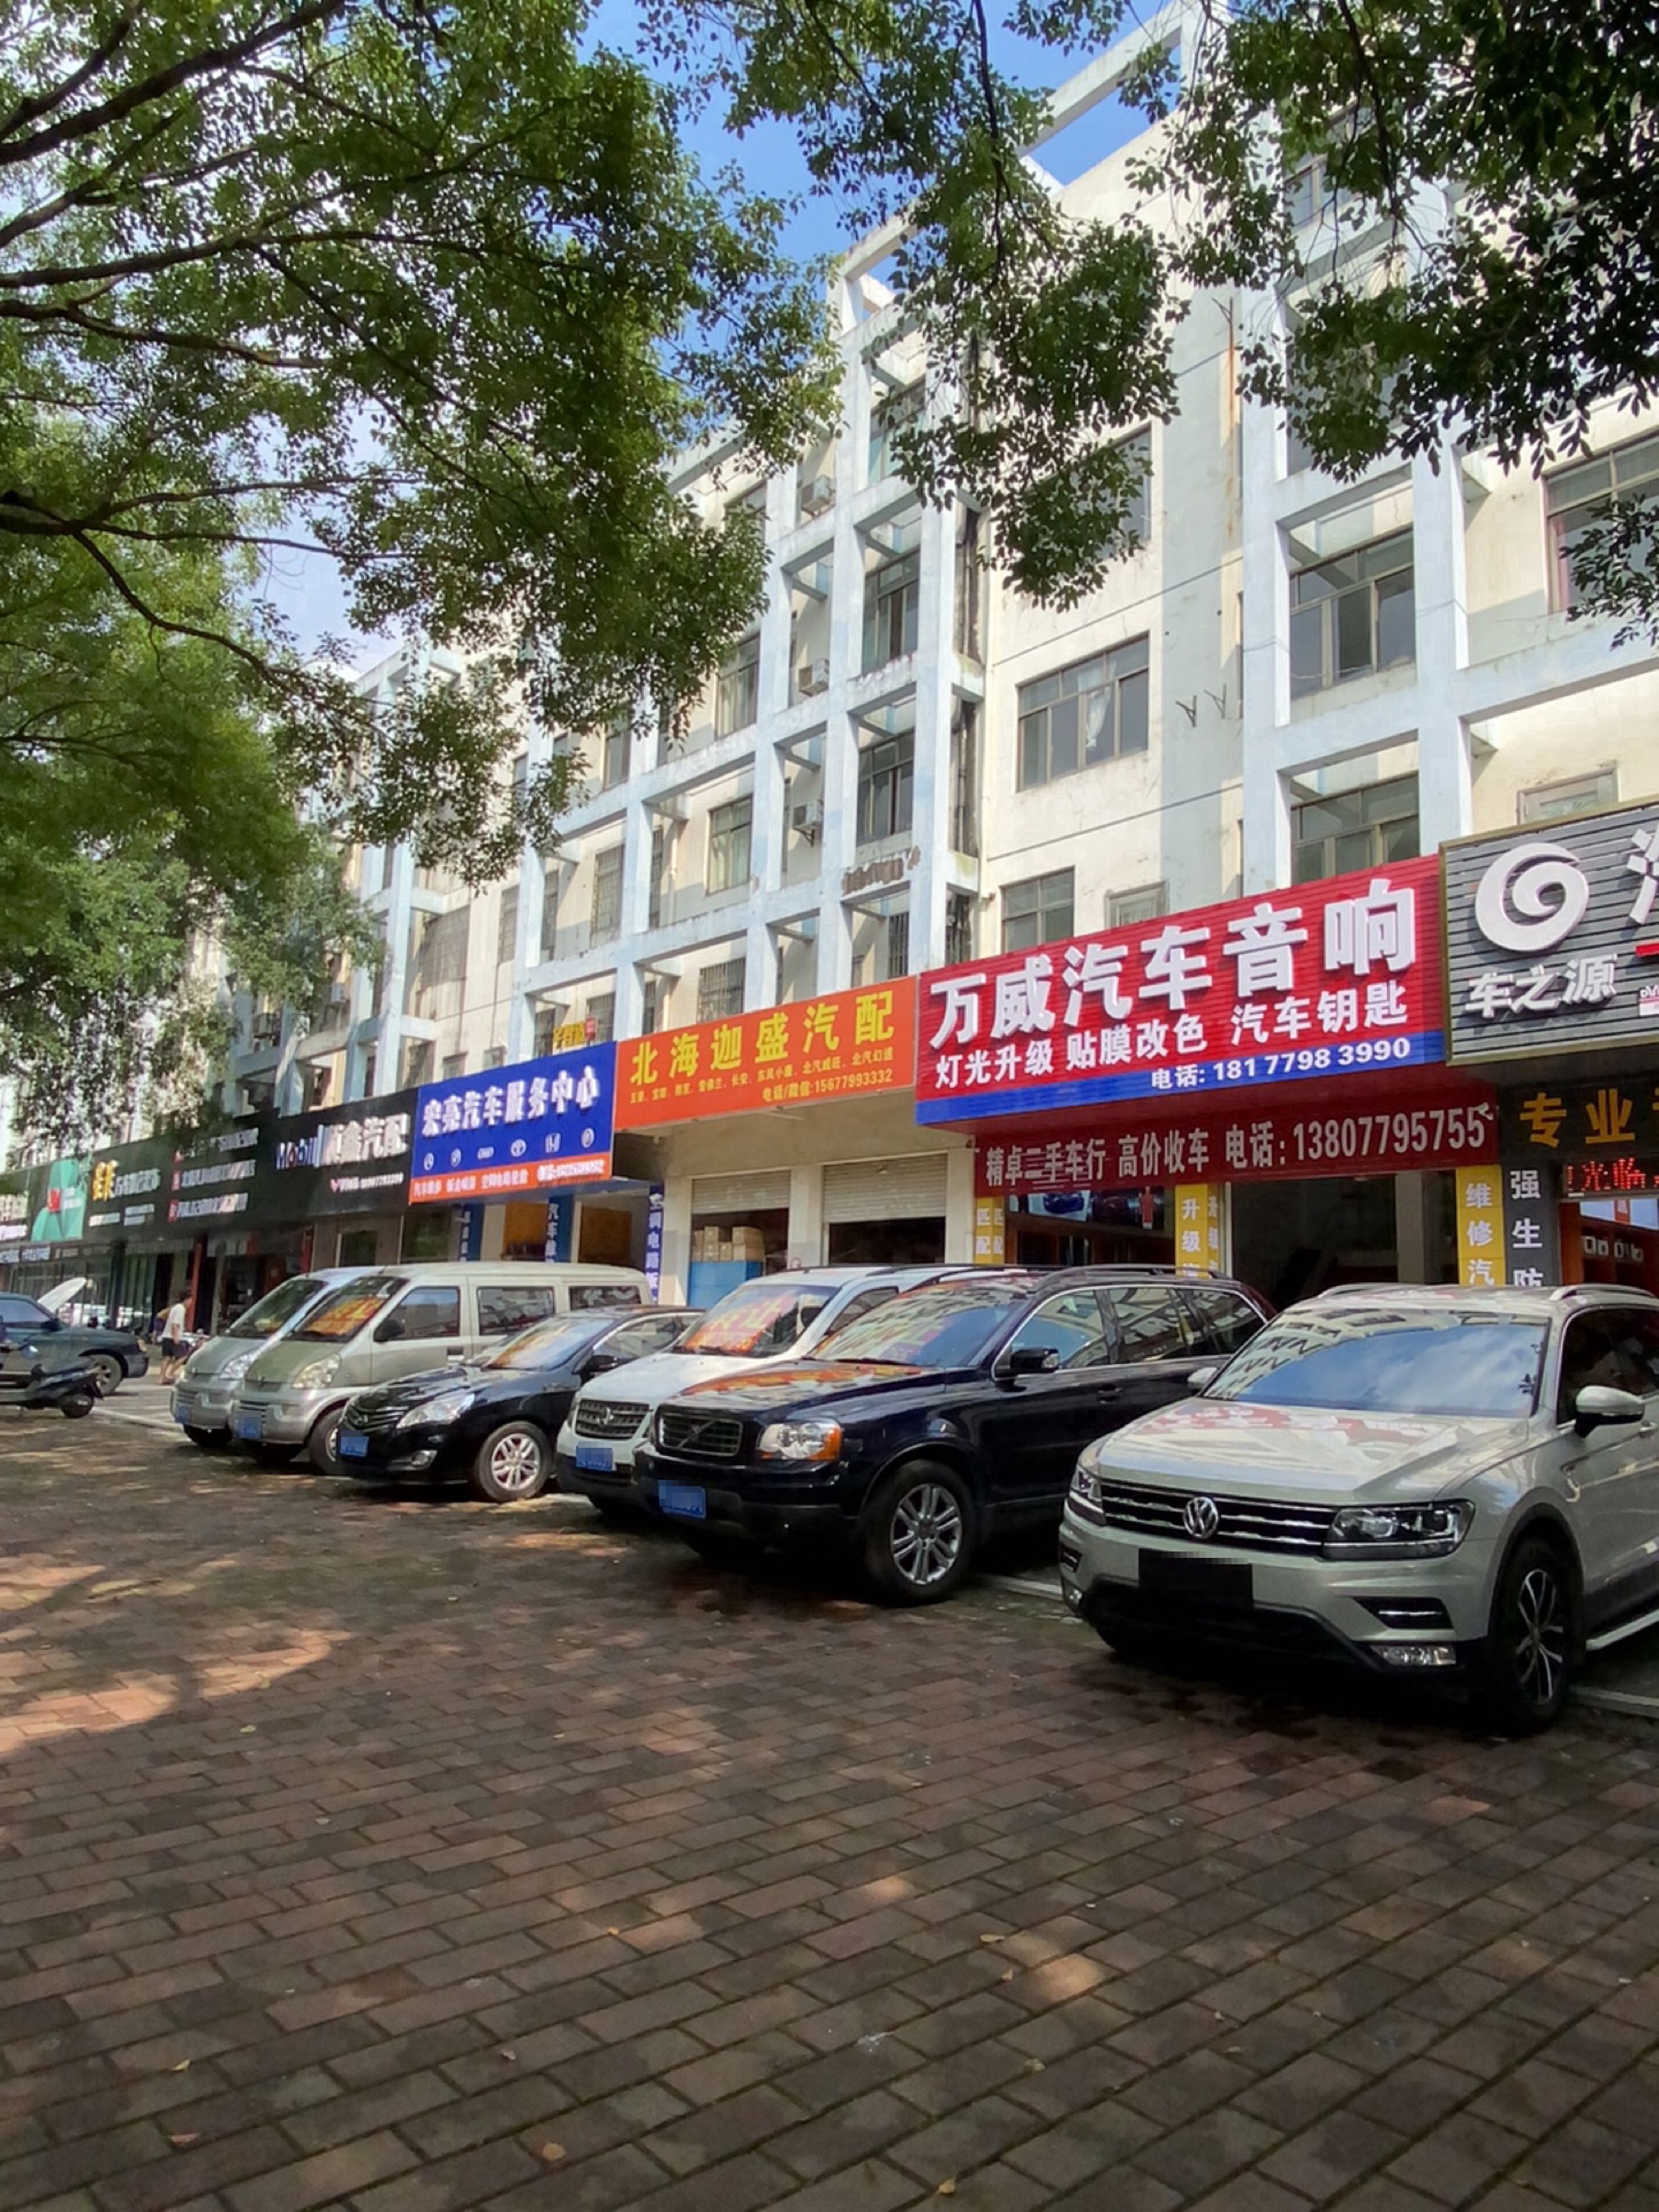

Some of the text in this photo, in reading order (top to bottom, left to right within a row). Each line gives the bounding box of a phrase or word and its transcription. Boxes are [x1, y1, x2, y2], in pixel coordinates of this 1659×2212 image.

[929, 878, 1416, 1050] 万威汽车音响
[1465, 953, 1618, 1018] 车之源
[630, 990, 894, 1085] 北海迦盛汽配
[935, 980, 1407, 1089] 灯光升级 贴膜改色 汽车钥匙
[1338, 1037, 1410, 1065] 3990
[1520, 1089, 1659, 1148] 专业
[986, 1137, 1106, 1187] 精卓二手车行
[1118, 1127, 1210, 1178] 高价收车
